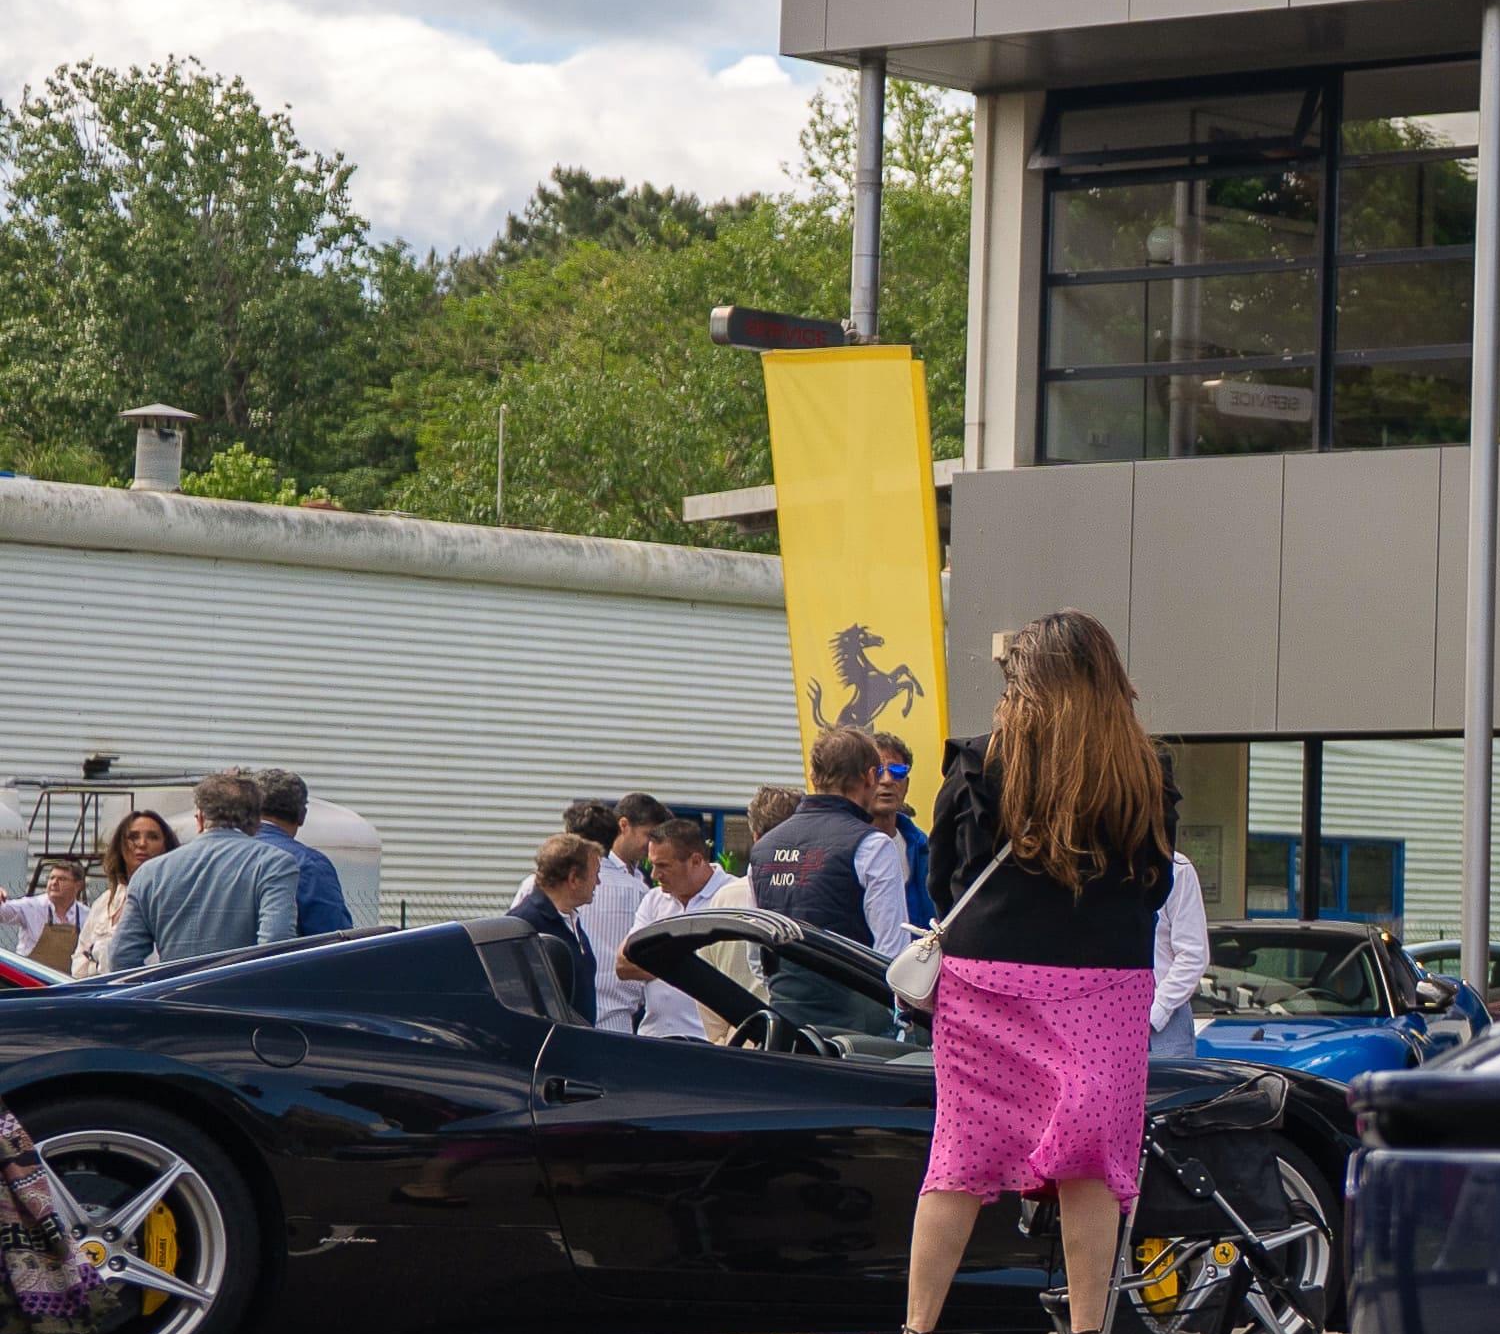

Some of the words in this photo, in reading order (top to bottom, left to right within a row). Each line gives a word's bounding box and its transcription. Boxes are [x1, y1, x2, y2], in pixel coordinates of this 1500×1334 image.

[744, 319, 828, 347] SERVICE
[774, 849, 800, 862] TOUR
[770, 873, 795, 886] AUTO
